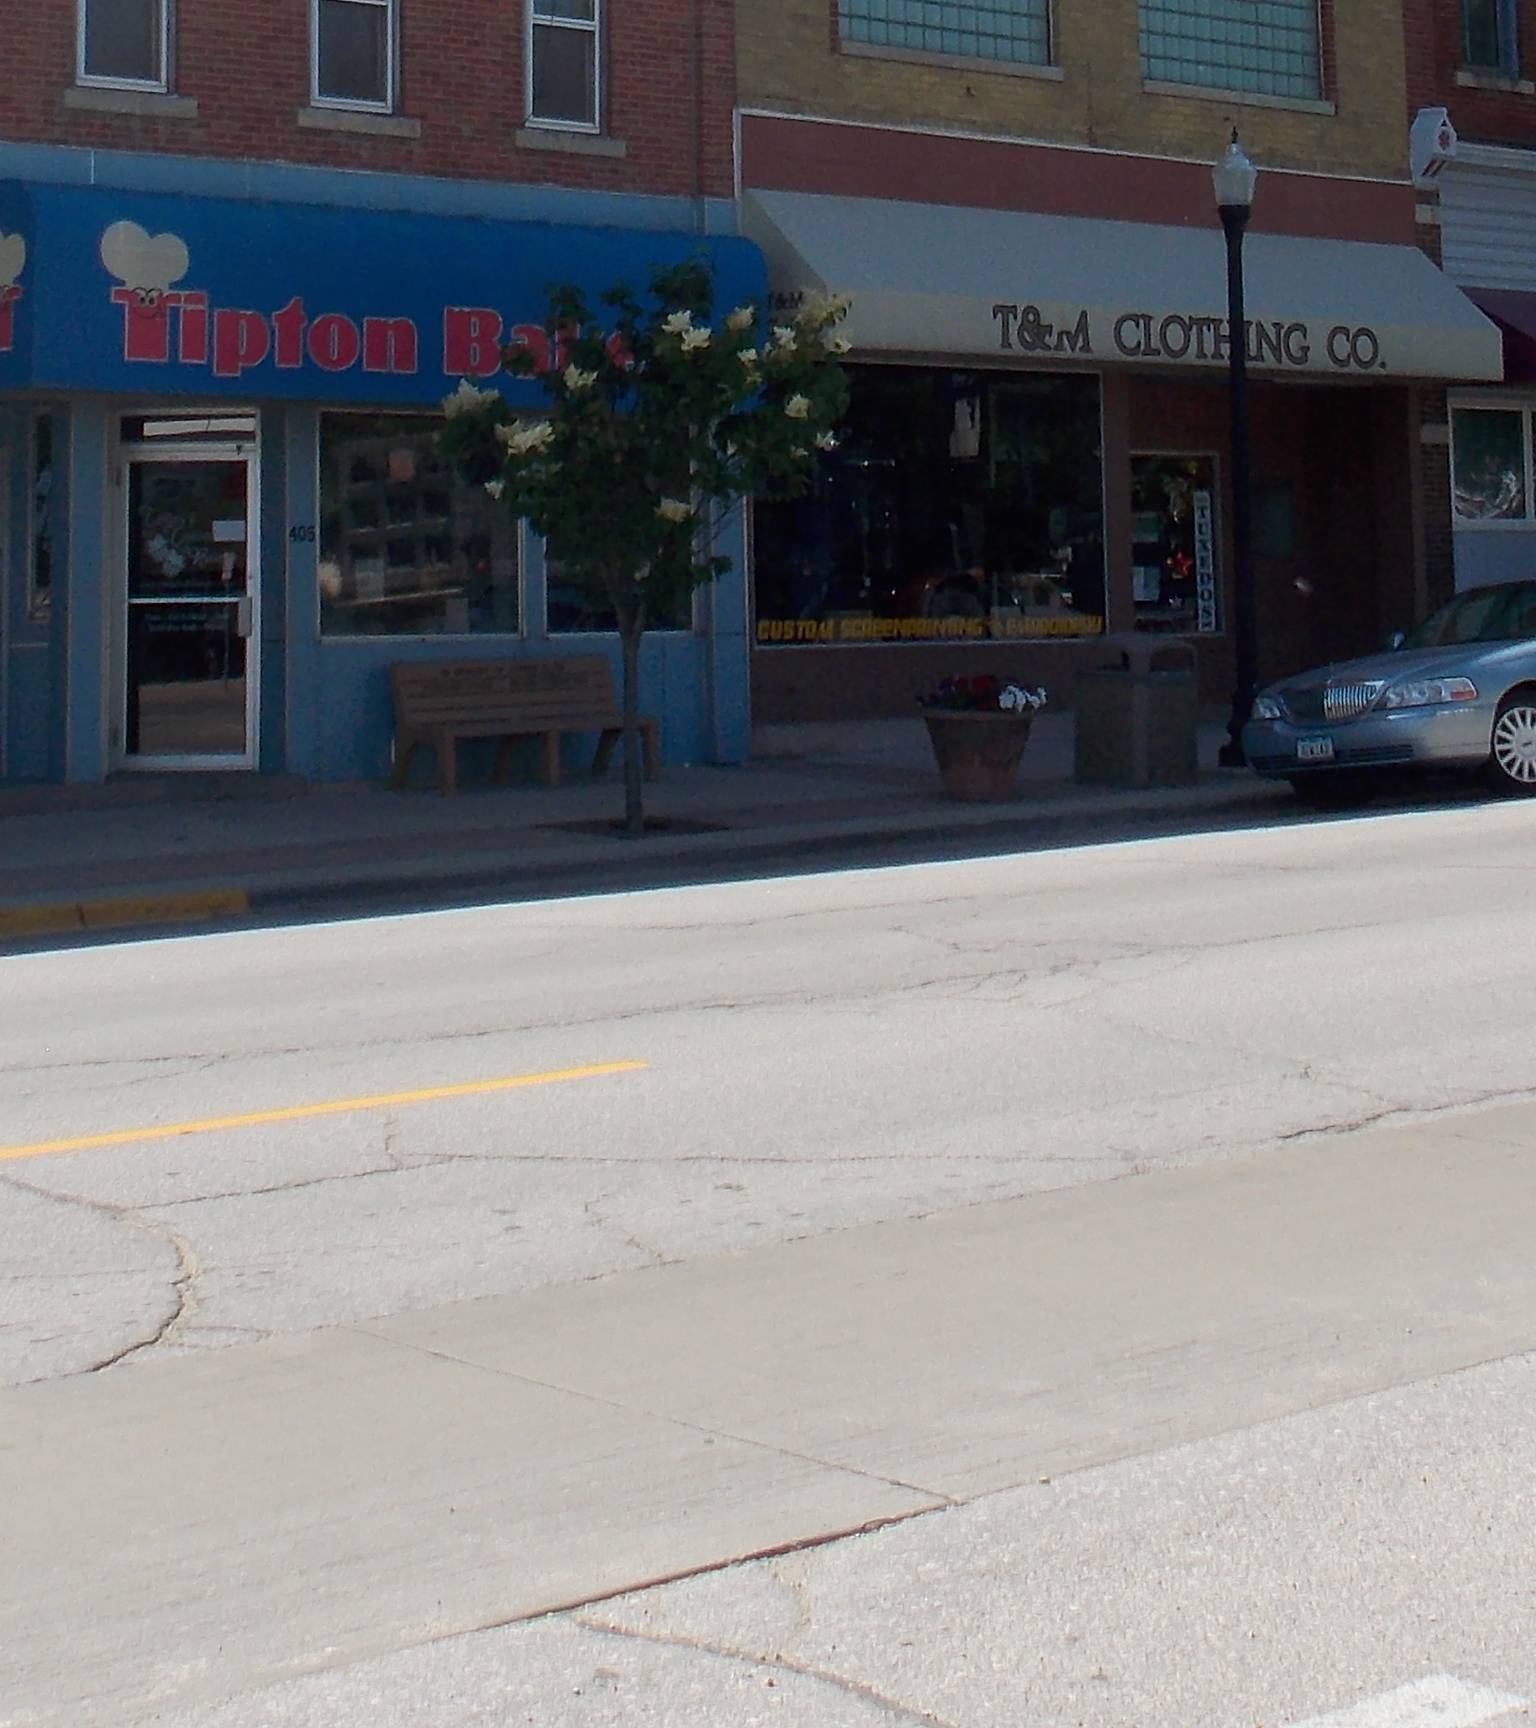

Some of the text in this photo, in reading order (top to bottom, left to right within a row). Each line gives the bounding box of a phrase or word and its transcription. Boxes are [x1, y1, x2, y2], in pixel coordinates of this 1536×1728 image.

[109, 286, 419, 377] Tipton
[992, 304, 1093, 354] T&M
[1326, 325, 1388, 370] CO.
[288, 526, 315, 543] 405
[756, 618, 834, 641] CUSTOM
